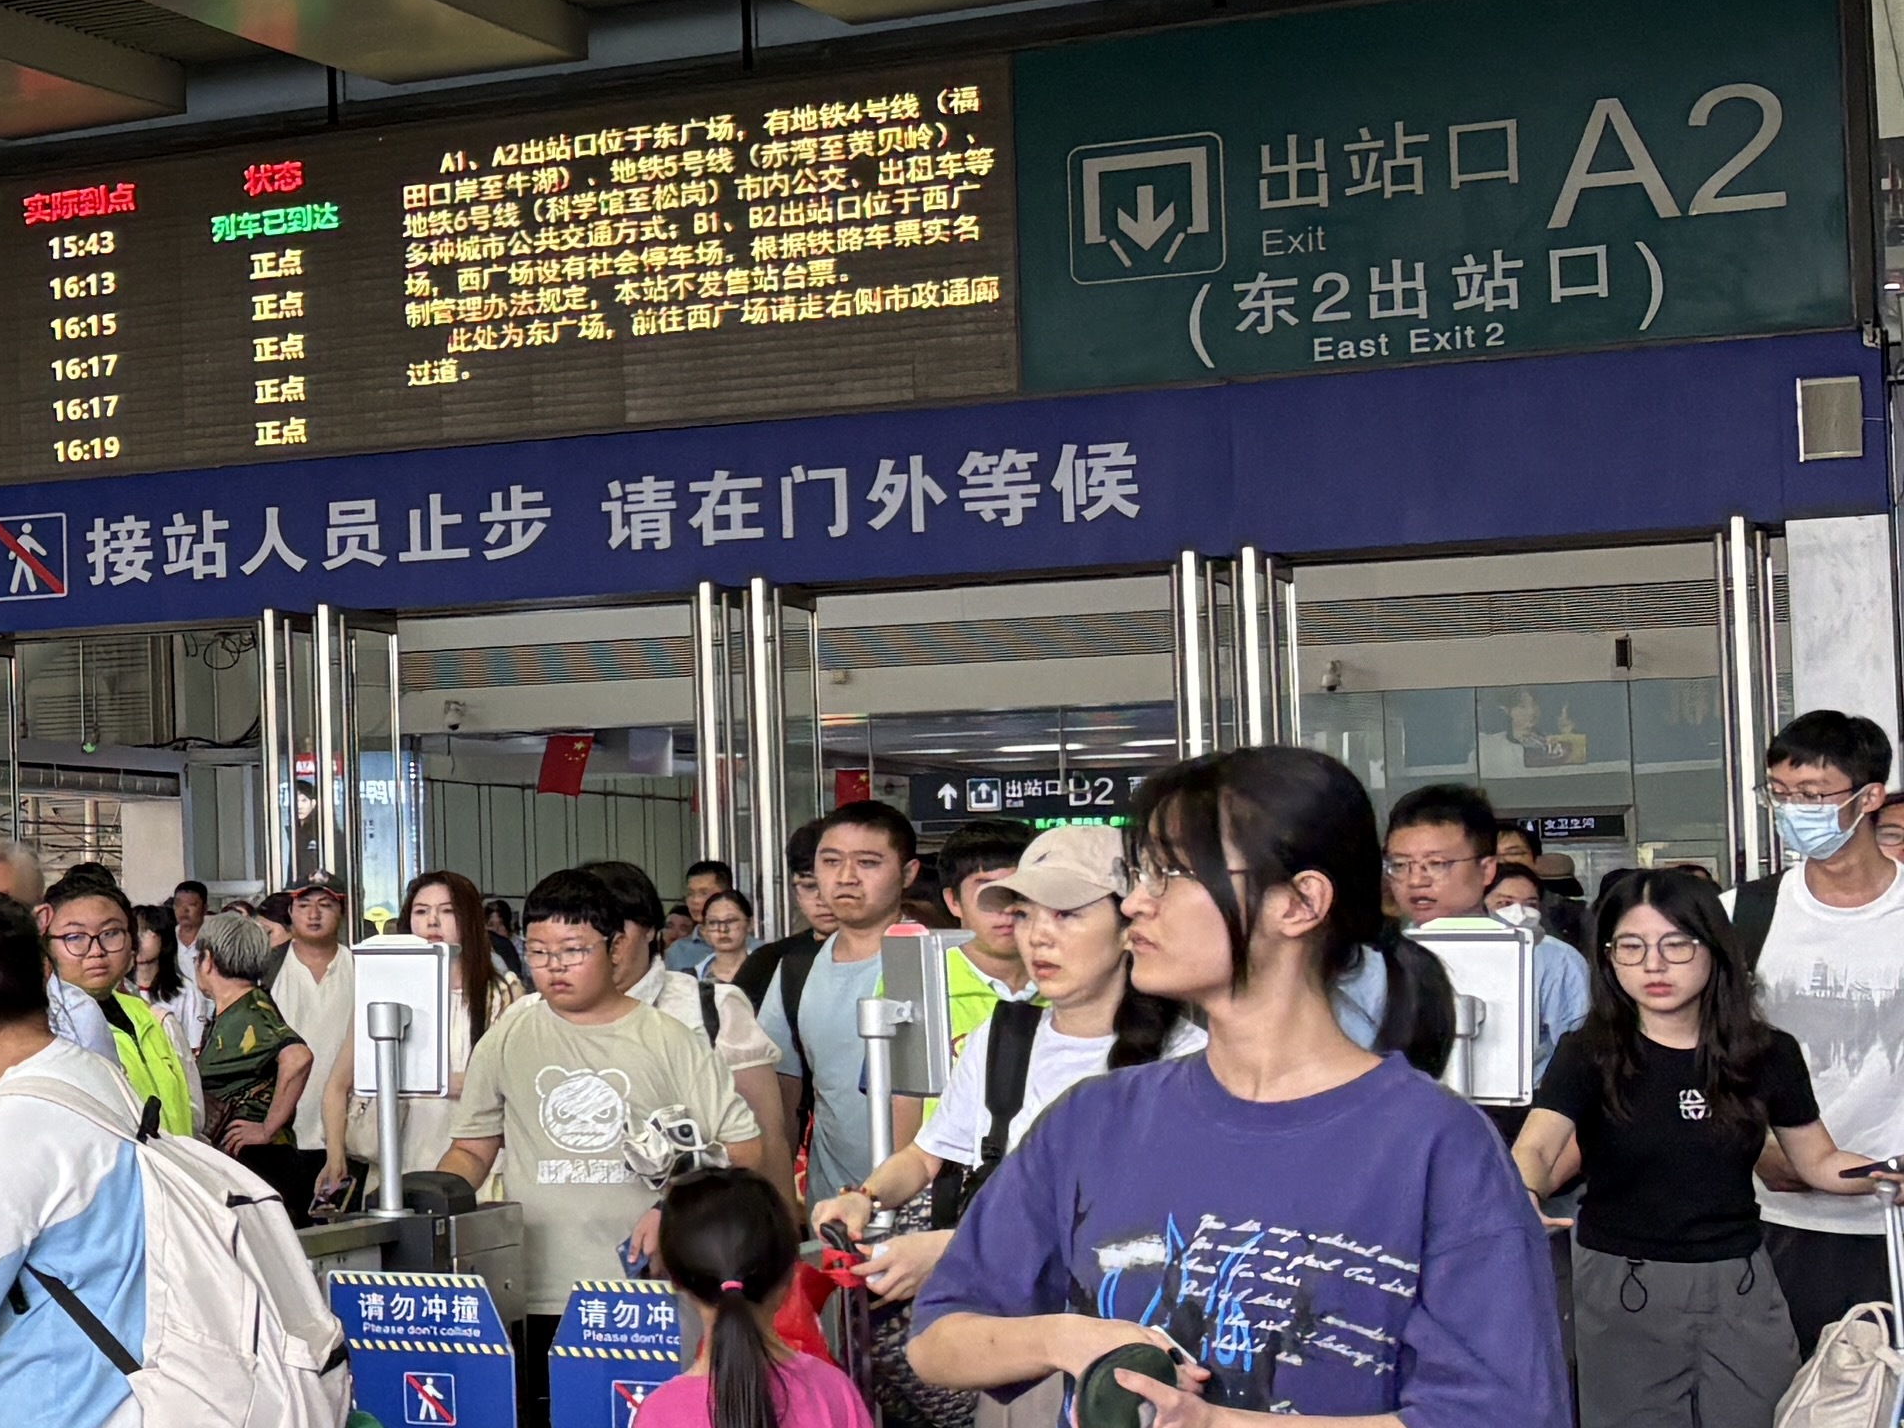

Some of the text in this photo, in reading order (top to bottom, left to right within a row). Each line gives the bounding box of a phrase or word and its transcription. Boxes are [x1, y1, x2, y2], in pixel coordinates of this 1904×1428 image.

[1259, 83, 1787, 229] 出站口 A2
[22, 182, 136, 225] 实际到点
[243, 160, 304, 197] 状态
[48, 230, 116, 260] 15:43
[211, 202, 342, 243] 列车已到达
[1262, 226, 1326, 256] Exit
[49, 271, 116, 300] 16:13
[249, 248, 304, 280] 正点
[50, 312, 117, 341] 16:15
[251, 290, 304, 321] 正点
[51, 353, 119, 382] 16:17
[252, 332, 305, 362] 正点
[1313, 322, 1505, 362] East Exit 2
[52, 394, 120, 422] 16:17
[254, 374, 306, 404] 正点
[53, 435, 121, 463] 16:19
[254, 416, 308, 446] 正点
[86, 442, 1141, 586] 接站人员止步 请在门外等候
[357, 1292, 481, 1324] 请勿冲撞
[362, 1321, 404, 1335] Please
[583, 1329, 629, 1343] Please
